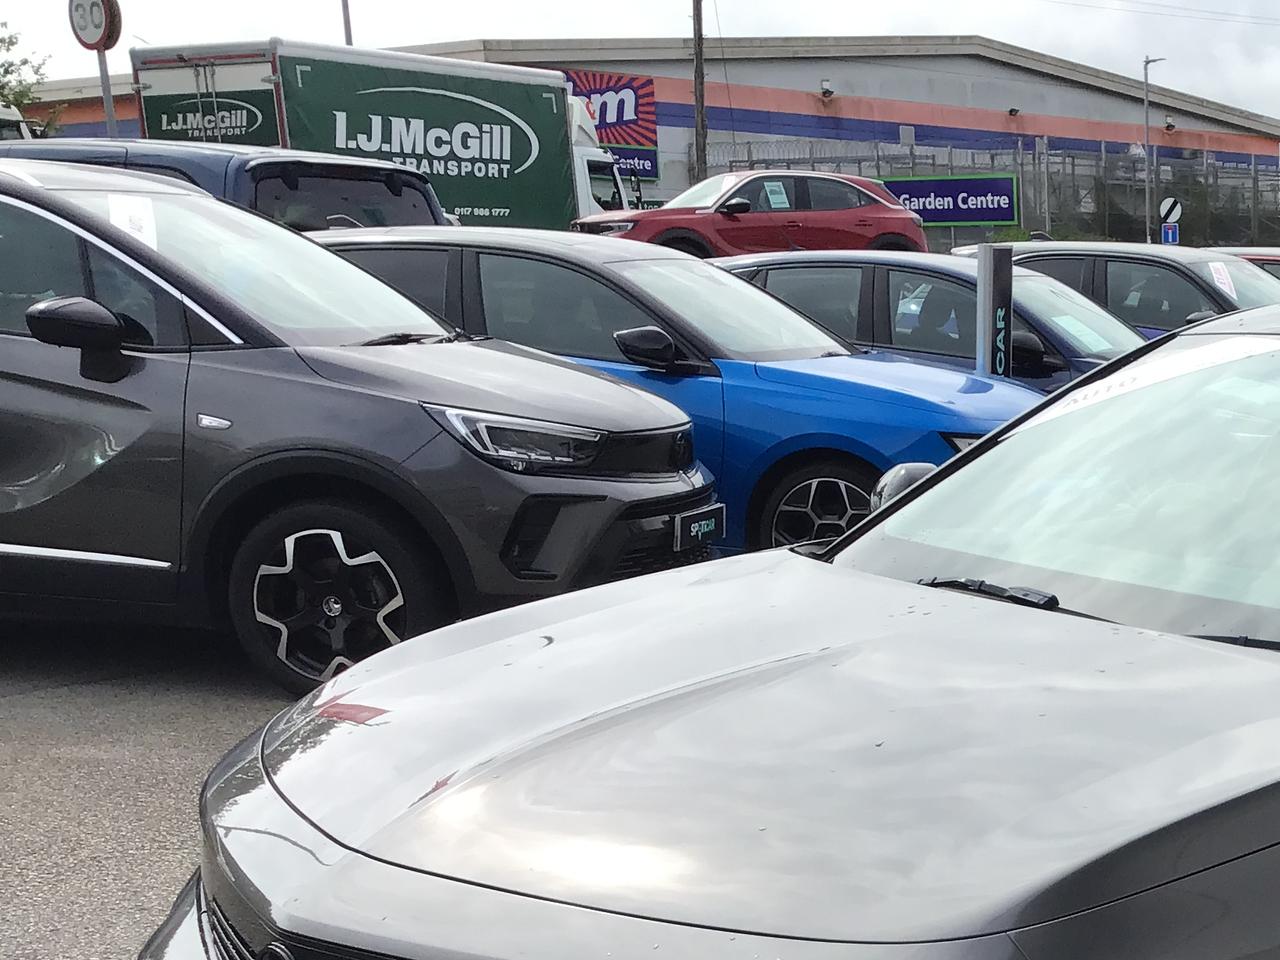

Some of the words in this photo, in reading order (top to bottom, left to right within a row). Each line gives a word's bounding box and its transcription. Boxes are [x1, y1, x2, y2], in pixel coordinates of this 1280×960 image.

[74, 3, 102, 31] 30
[900, 193, 953, 210] Garden
[957, 192, 1009, 209] Centre
